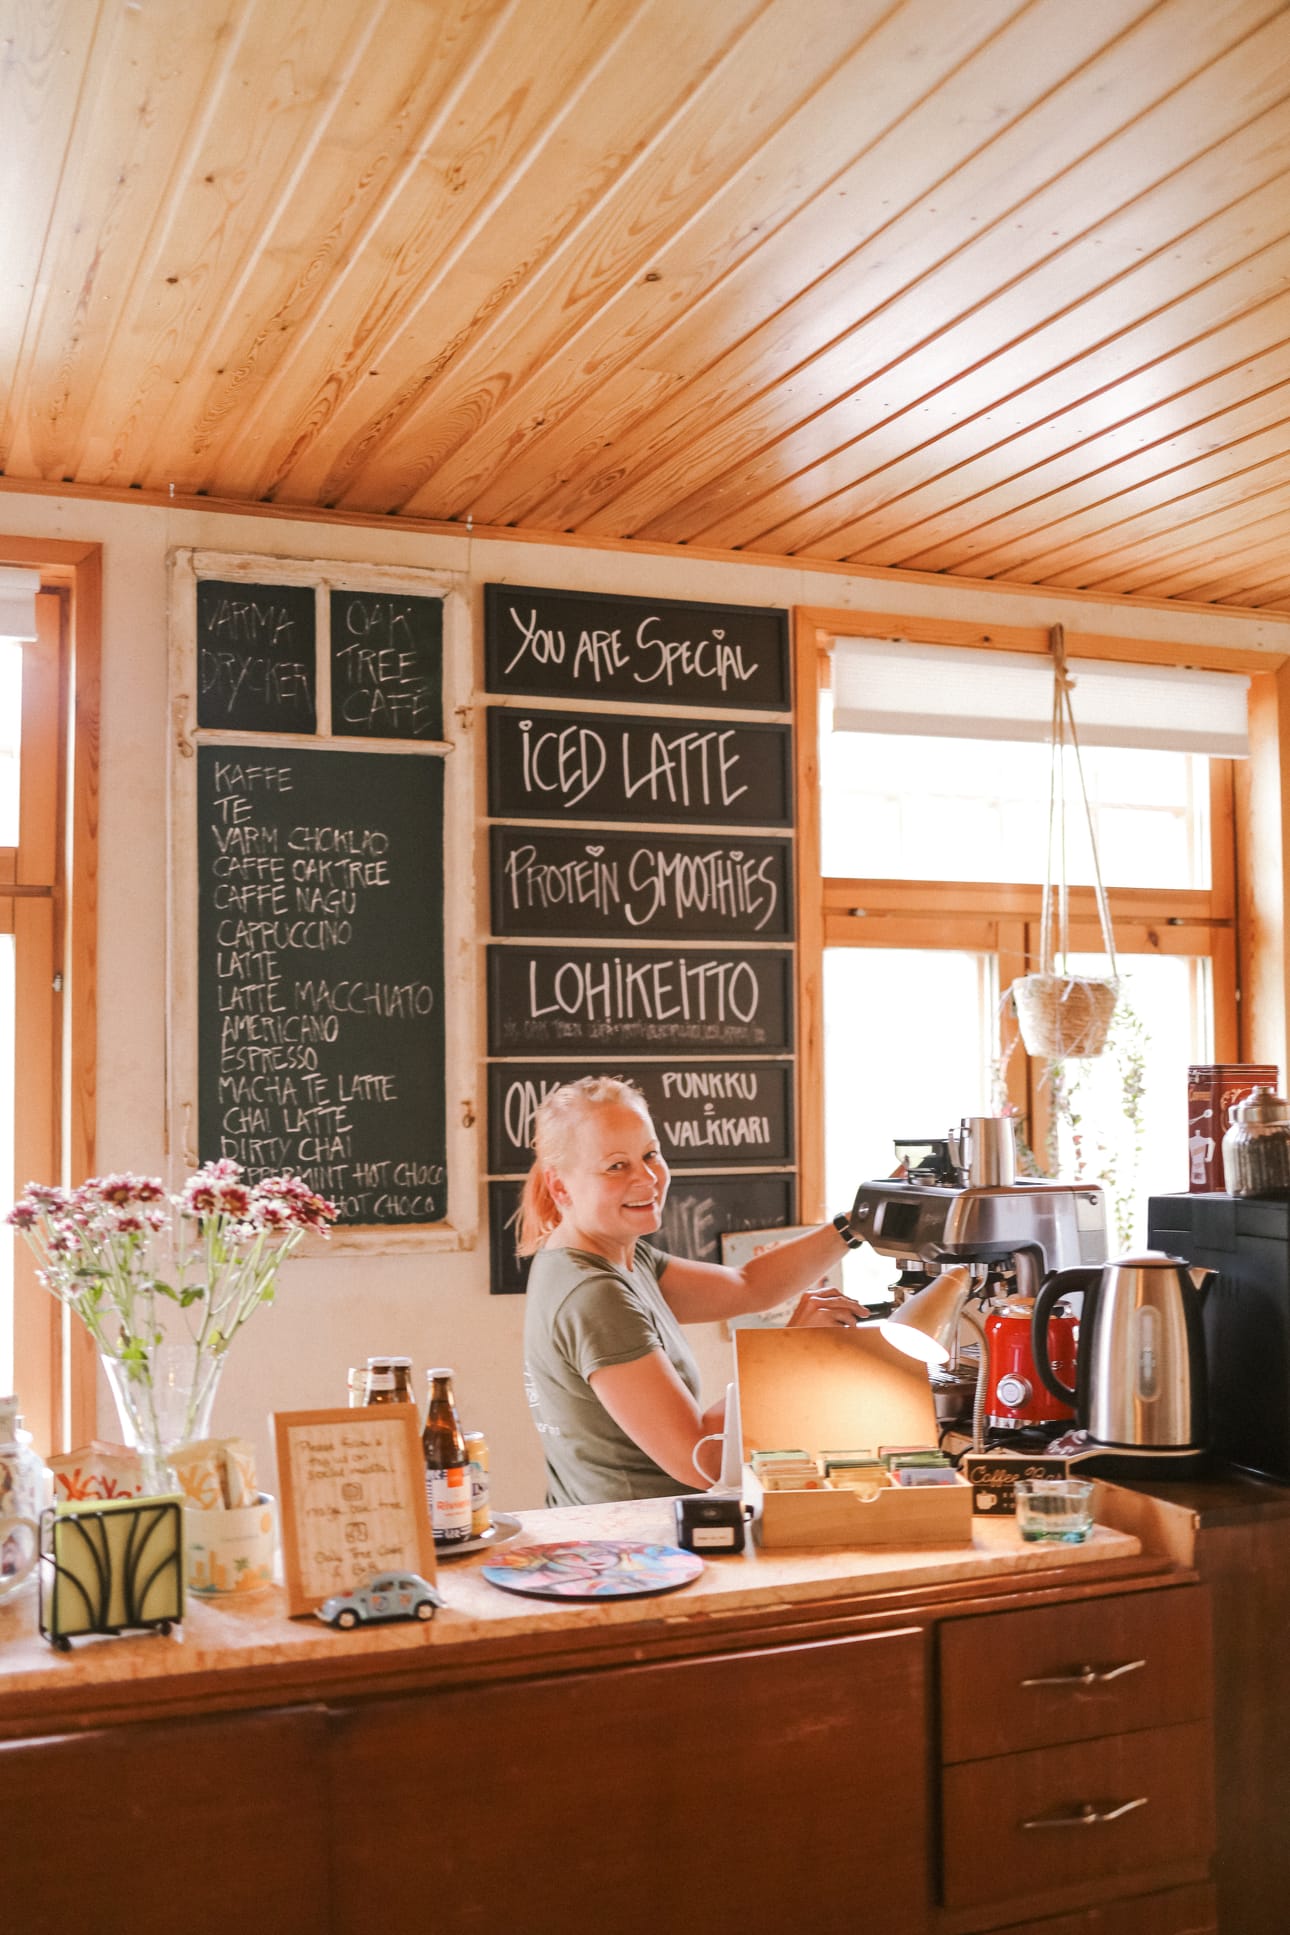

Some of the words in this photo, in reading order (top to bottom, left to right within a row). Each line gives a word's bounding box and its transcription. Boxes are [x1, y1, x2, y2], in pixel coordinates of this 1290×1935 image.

[346, 600, 416, 648] OAK
[335, 643, 424, 685] TREE
[504, 607, 566, 674] YOU
[573, 629, 630, 682] ARE
[633, 616, 758, 691] SPECIAL
[214, 762, 293, 792] KAFFE
[622, 729, 748, 806] LATTE
[213, 795, 253, 824] TE
[211, 825, 278, 855] VARM
[212, 856, 285, 882] CAFFE
[213, 884, 288, 915] CAFFE
[296, 887, 357, 915] NAGU
[504, 845, 620, 915] PROTEIN
[624, 848, 777, 931] SMOOTHIES
[216, 920, 352, 951] CAPPUCCINO
[217, 951, 282, 981] LATTE
[218, 982, 286, 1012] LATTE
[295, 980, 434, 1018] MACCHIATO
[529, 957, 759, 1022] LOHIKEITTO
[221, 1014, 339, 1044] AMERICANO
[220, 1045, 318, 1073] ESPRESSO
[218, 1076, 298, 1105] MACHA
[301, 1073, 331, 1105] TE
[338, 1074, 398, 1103] LATTE
[661, 1072, 758, 1100] PUNKKU
[223, 1106, 272, 1134] CHAI
[284, 1106, 353, 1135] LATTE
[663, 1116, 770, 1147] VALKKARI
[220, 1136, 292, 1167] DIRTY
[298, 1137, 352, 1163] CHAI
[352, 1160, 392, 1188] HOT
[969, 1465, 1021, 1488] Coffee
